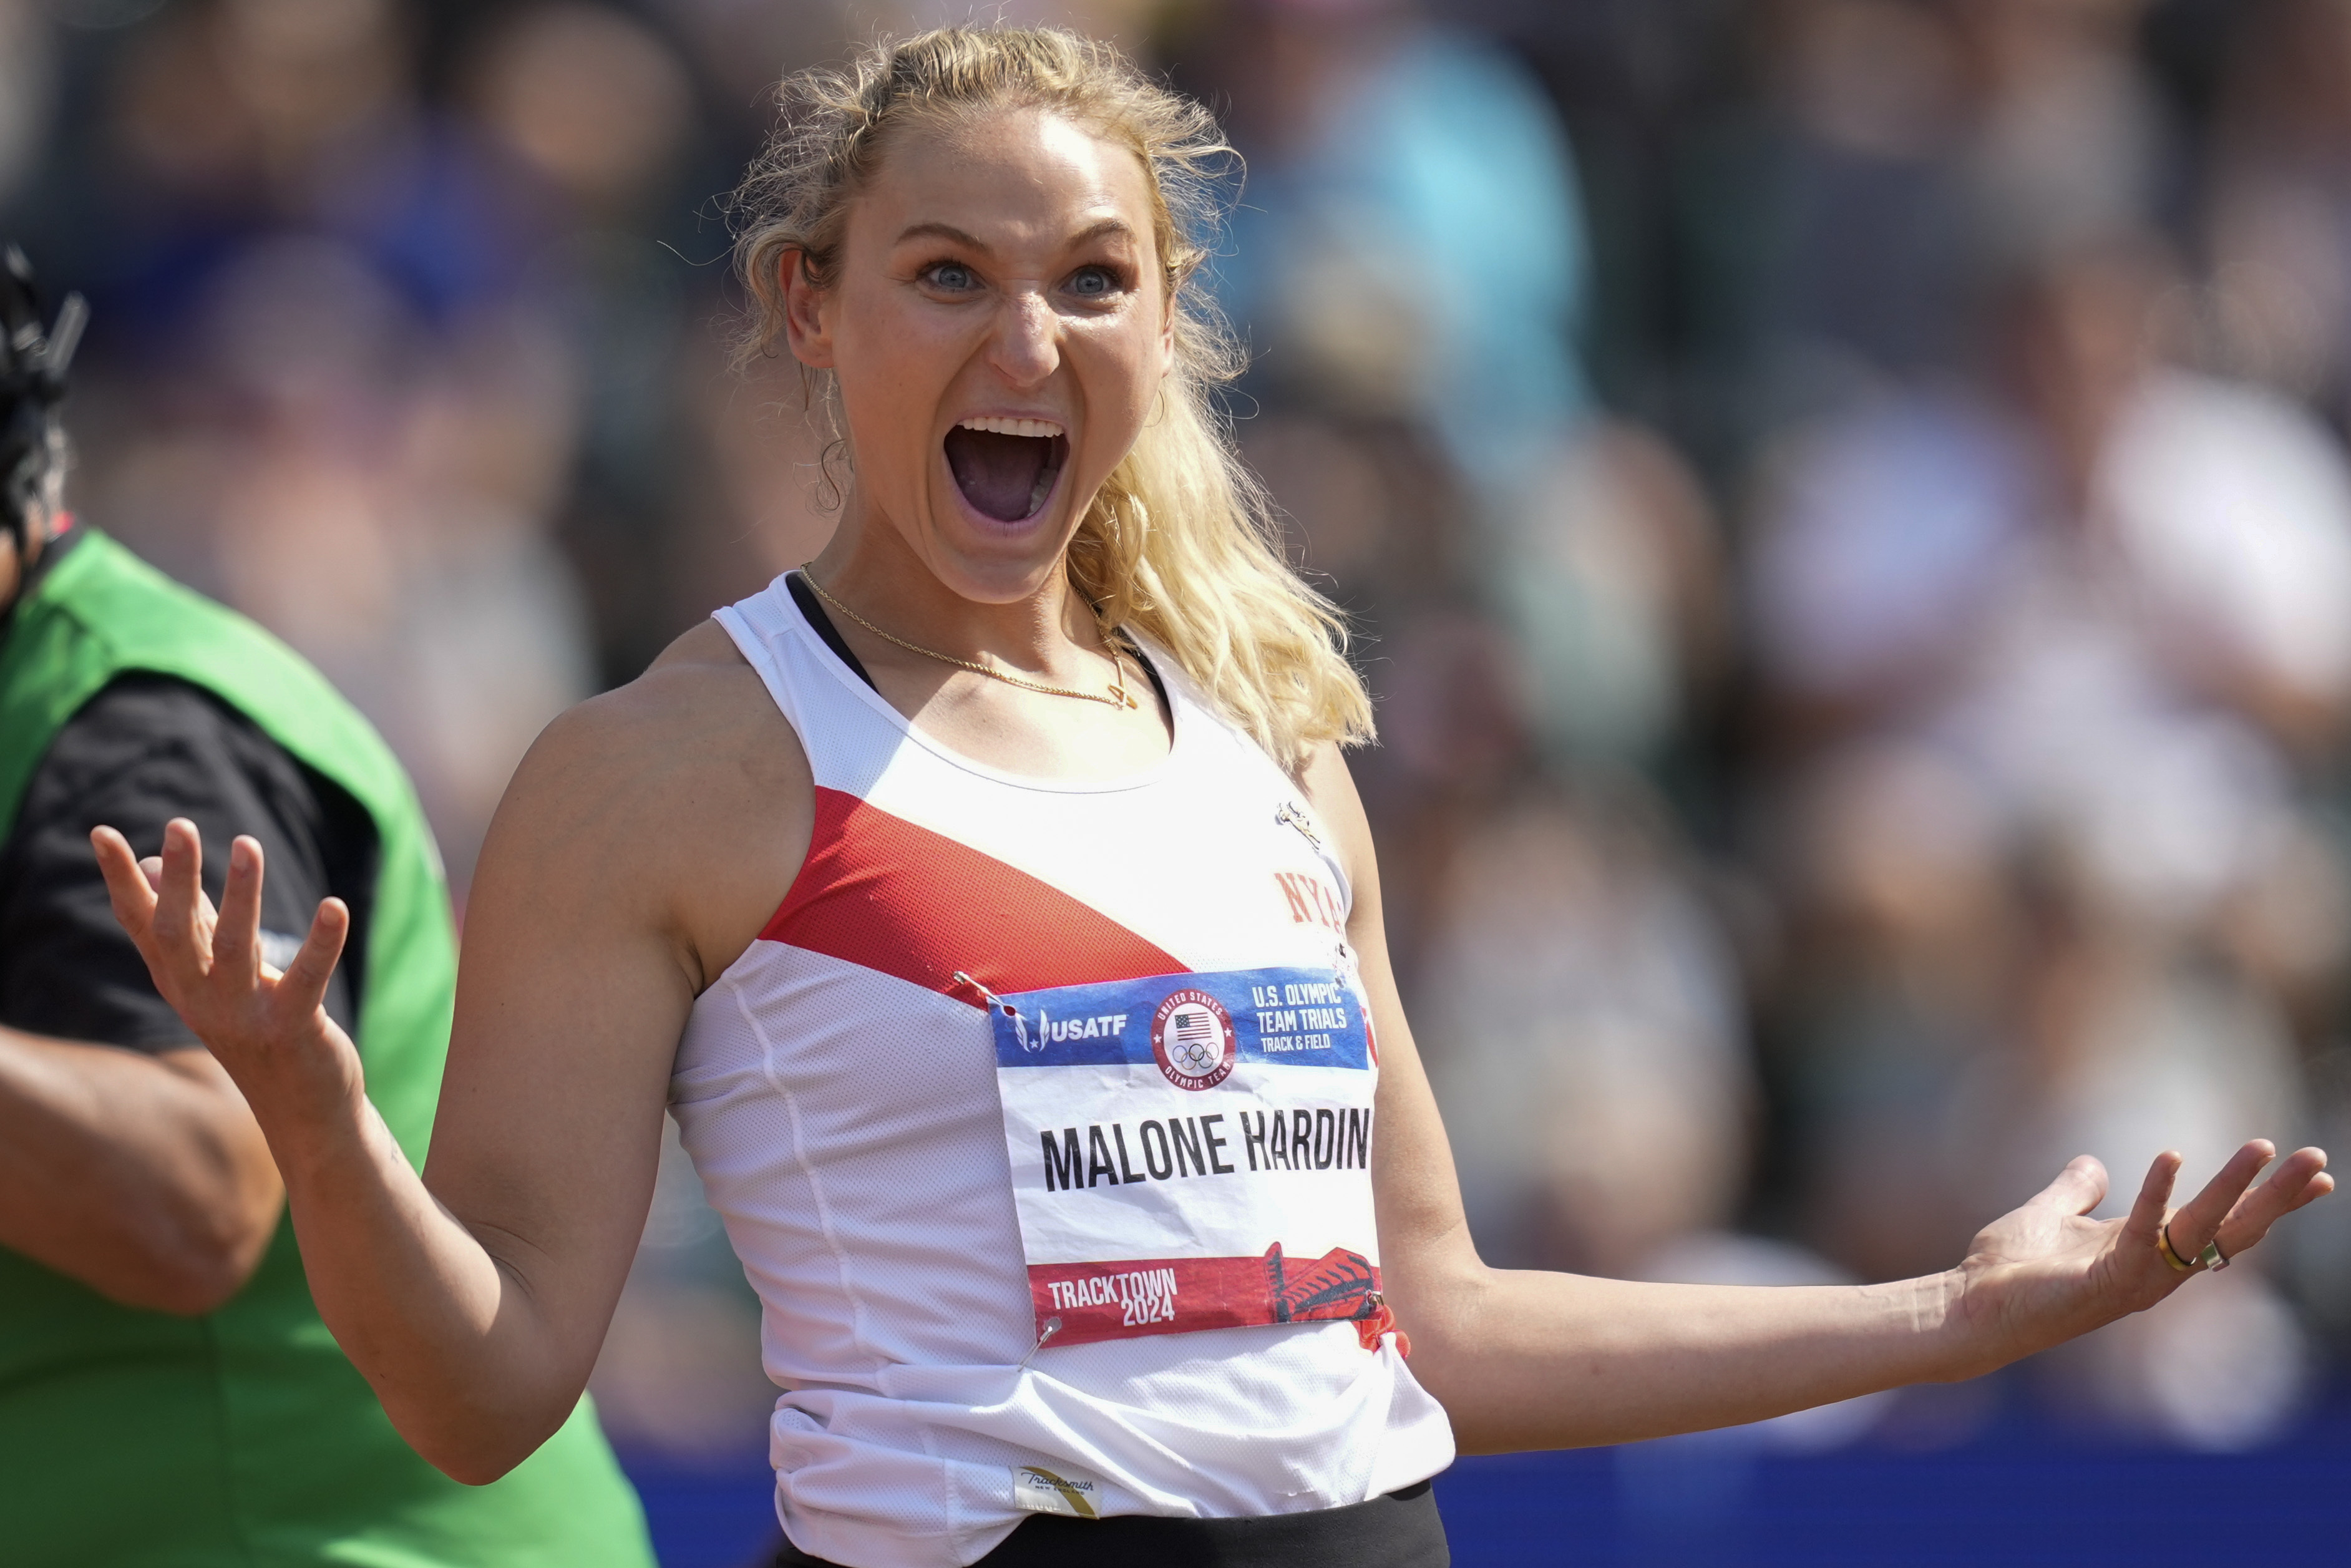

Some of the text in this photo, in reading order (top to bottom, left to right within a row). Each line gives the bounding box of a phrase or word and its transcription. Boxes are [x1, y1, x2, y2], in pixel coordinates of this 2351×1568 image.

[1273, 872, 1345, 940] NYA
[1157, 991, 1223, 1020] UNITED STATES
[1252, 983, 1341, 1008] U.S. OLYMPIC
[1051, 1014, 1127, 1042] USATF
[1256, 1008, 1347, 1033] TEAM TRIALS
[1261, 1033, 1331, 1053] TRACK & FIELD
[1165, 1061, 1231, 1089] OLYMPIC TEAM
[1040, 1108, 1370, 1192] MALONE HARDIN
[1048, 1268, 1178, 1310] TRACKTOWN
[1121, 1292, 1175, 1327] 2024
[1021, 1472, 1094, 1491] Tracksmith
[1054, 1487, 1084, 1495] ENGLAND
